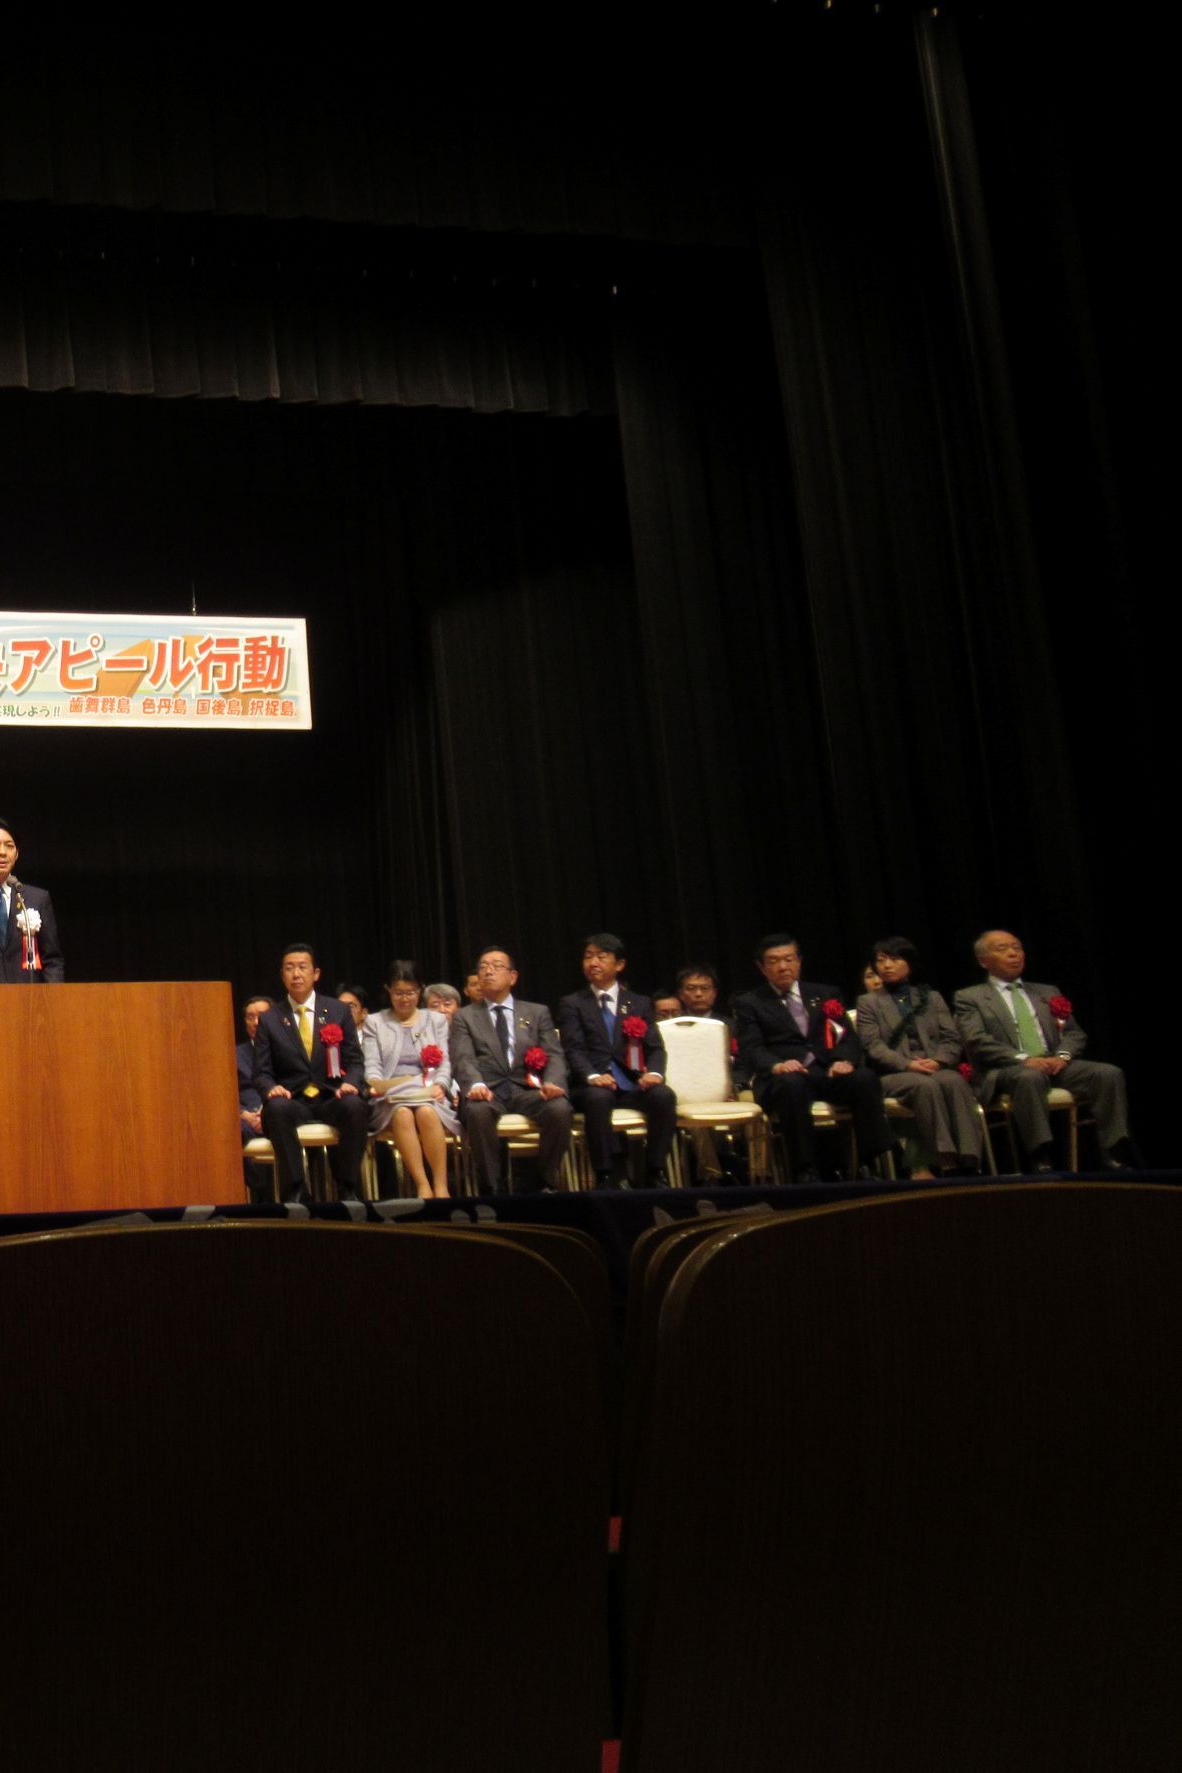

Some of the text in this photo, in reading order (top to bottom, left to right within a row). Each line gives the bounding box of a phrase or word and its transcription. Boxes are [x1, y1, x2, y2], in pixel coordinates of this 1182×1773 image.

[69, 698, 295, 717] 歯舞群島 色丹島 国後島 択捉島
